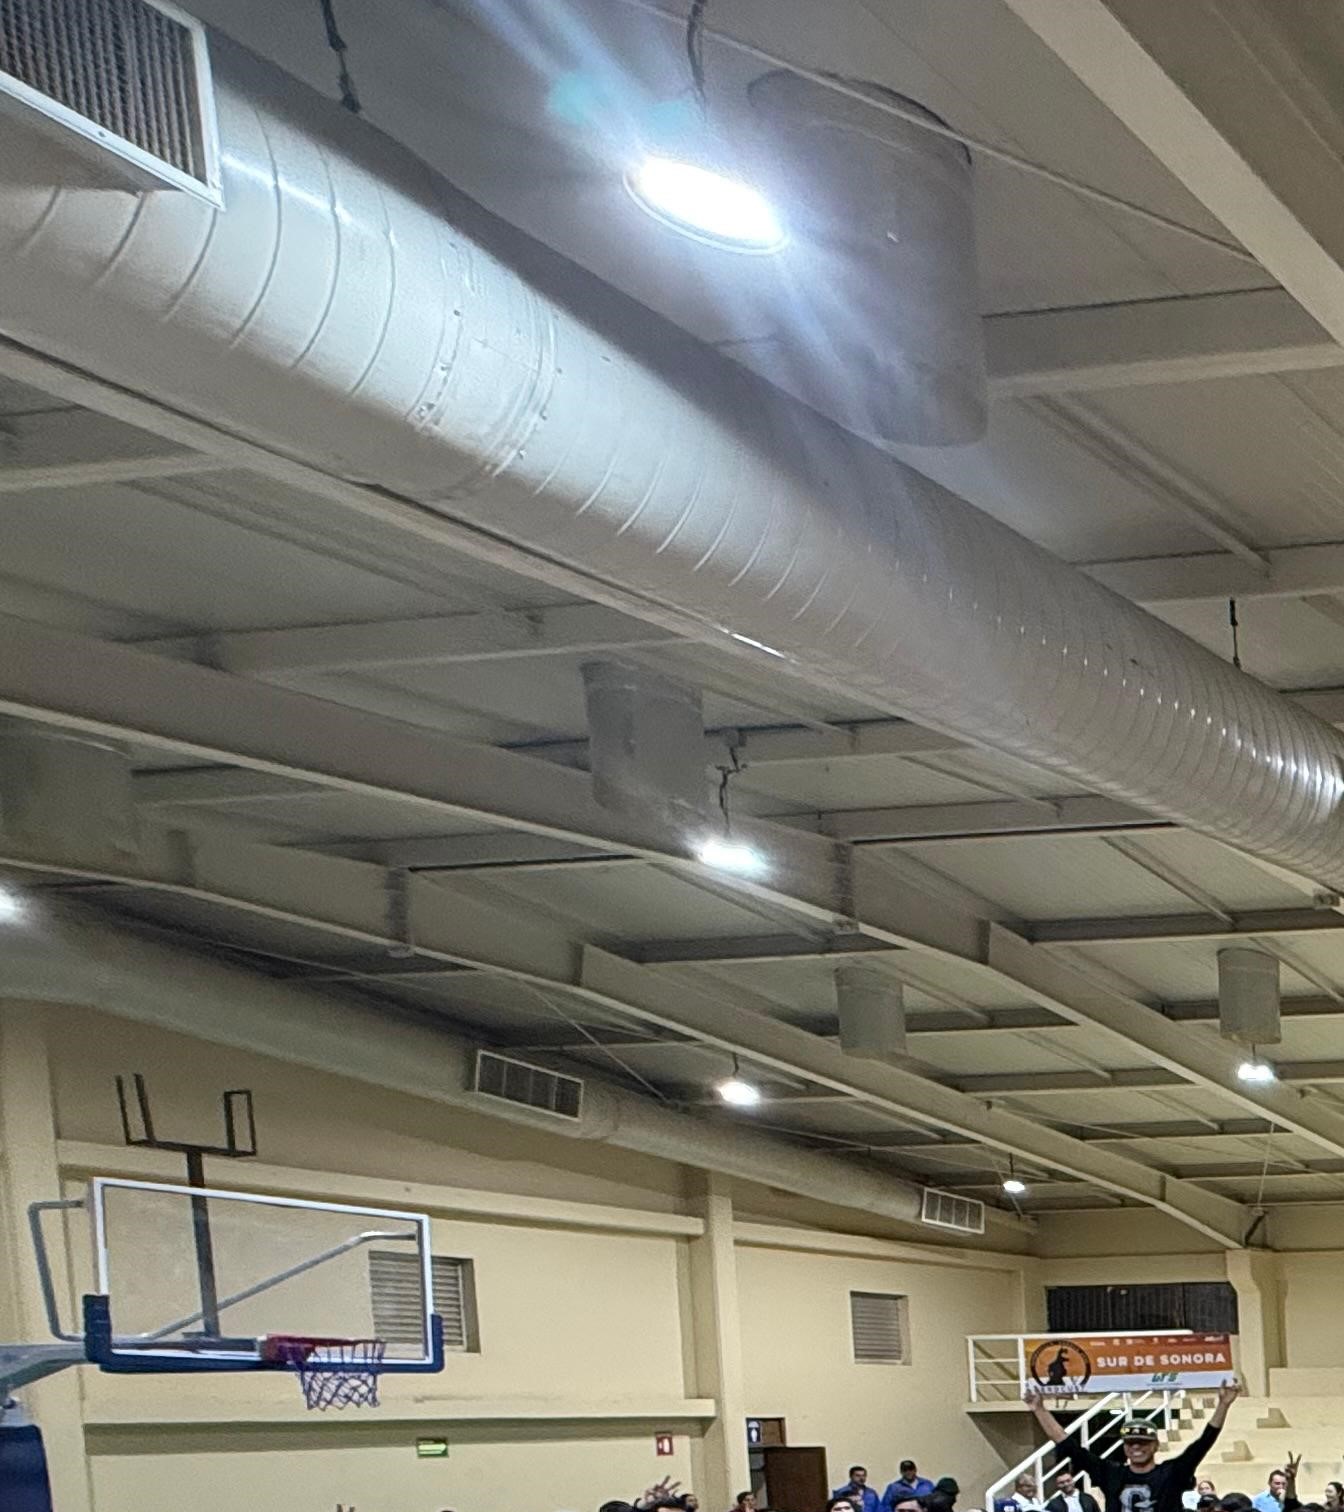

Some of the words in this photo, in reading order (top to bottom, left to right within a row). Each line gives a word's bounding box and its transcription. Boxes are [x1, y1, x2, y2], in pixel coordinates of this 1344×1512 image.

[1096, 1356, 1128, 1368] SUR
[1133, 1355, 1155, 1367] DE
[1160, 1353, 1226, 1366] SONORA
